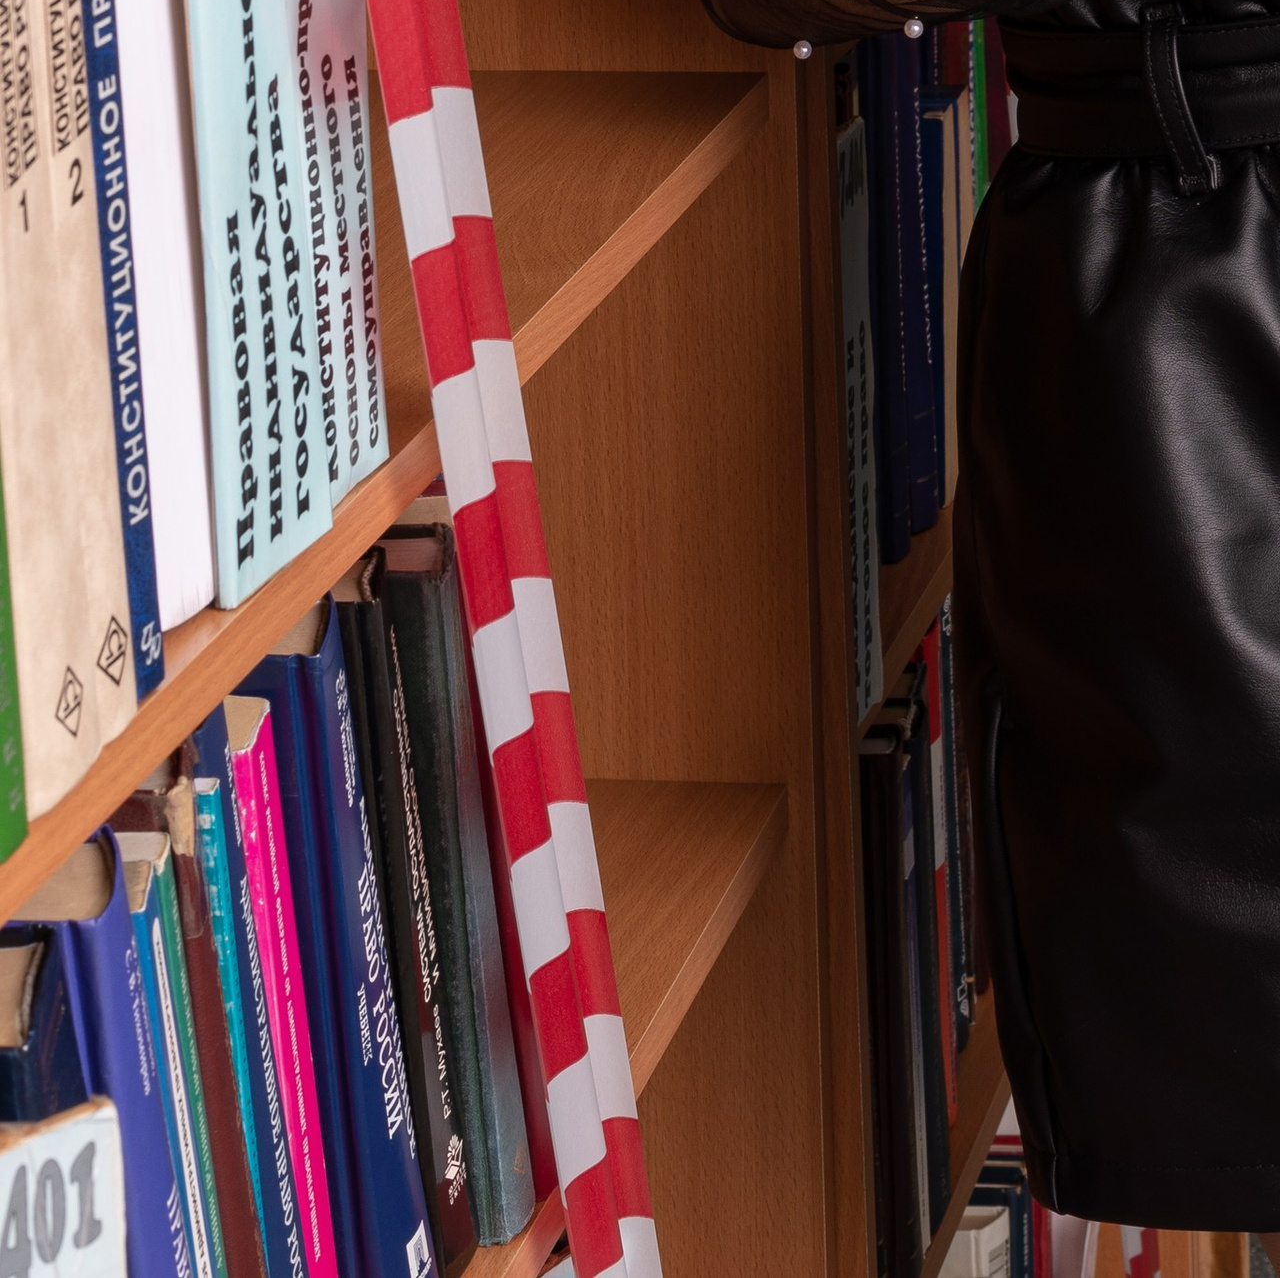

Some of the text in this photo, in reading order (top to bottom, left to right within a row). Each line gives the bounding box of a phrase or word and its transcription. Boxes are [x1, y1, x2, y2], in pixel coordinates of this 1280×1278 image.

[14, 44, 39, 170] ПРАВО
[69, 16, 90, 137] ПРАВО
[18, 188, 30, 233] 1
[68, 157, 84, 207] 2
[96, 72, 153, 526] КОНСТИТУЦИОННОЕ
[262, 72, 316, 521] государства
[319, 52, 363, 467] основы местного
[343, 54, 386, 449] самоуправления
[220, 209, 262, 571] Правовая
[856, 319, 877, 709] торговое право
[265, 806, 280, 894] РОССИЙСКОЙ
[392, 688, 433, 1002] СИСТЕМА ГОСУДАРСТВЕННОГО
[274, 897, 289, 974] ФЕДЕРАЦИИ
[283, 977, 291, 996] ОБ
[430, 963, 441, 985] И
[357, 982, 373, 1066] УЧЕБНИК
[358, 862, 402, 1140] ПРАВО РОССИИ
[433, 1003, 446, 1081] Мухаев
[285, 999, 309, 1135] АДМИНИСТРАТИВНЫХ
[166, 1179, 191, 1278] ПРАВ
[273, 1143, 297, 1226] ПРАВО
[300, 1137, 324, 1262] ПРАВОНАРУШЕНИЯХ
